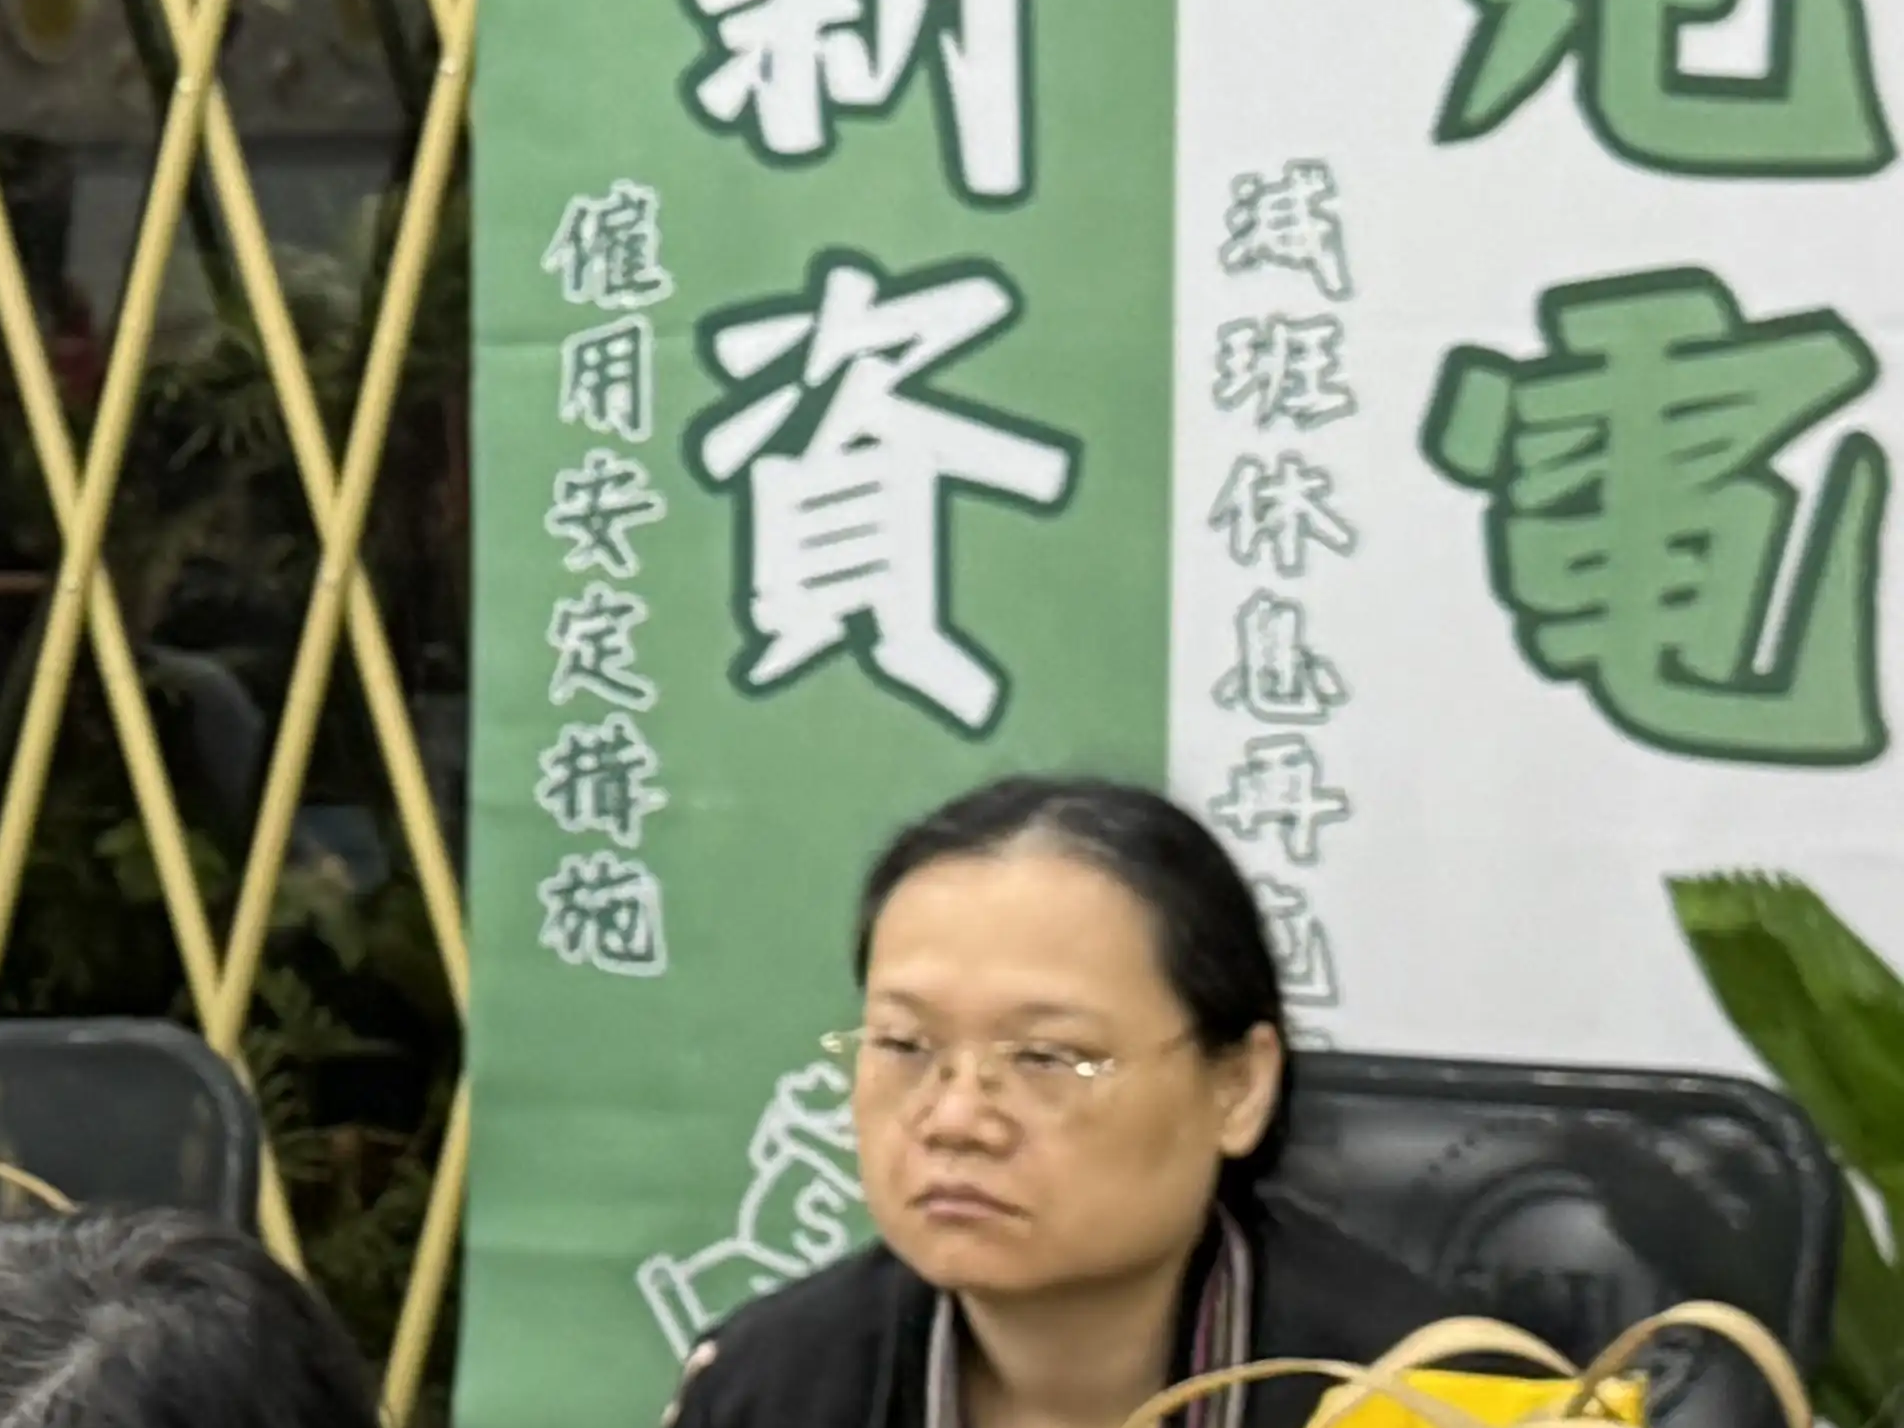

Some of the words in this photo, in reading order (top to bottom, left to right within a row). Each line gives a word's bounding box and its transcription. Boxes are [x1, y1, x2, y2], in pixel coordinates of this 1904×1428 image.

[536, 179, 673, 978] 僱用安定措施
[1207, 161, 1358, 1052] 減班休息再充
